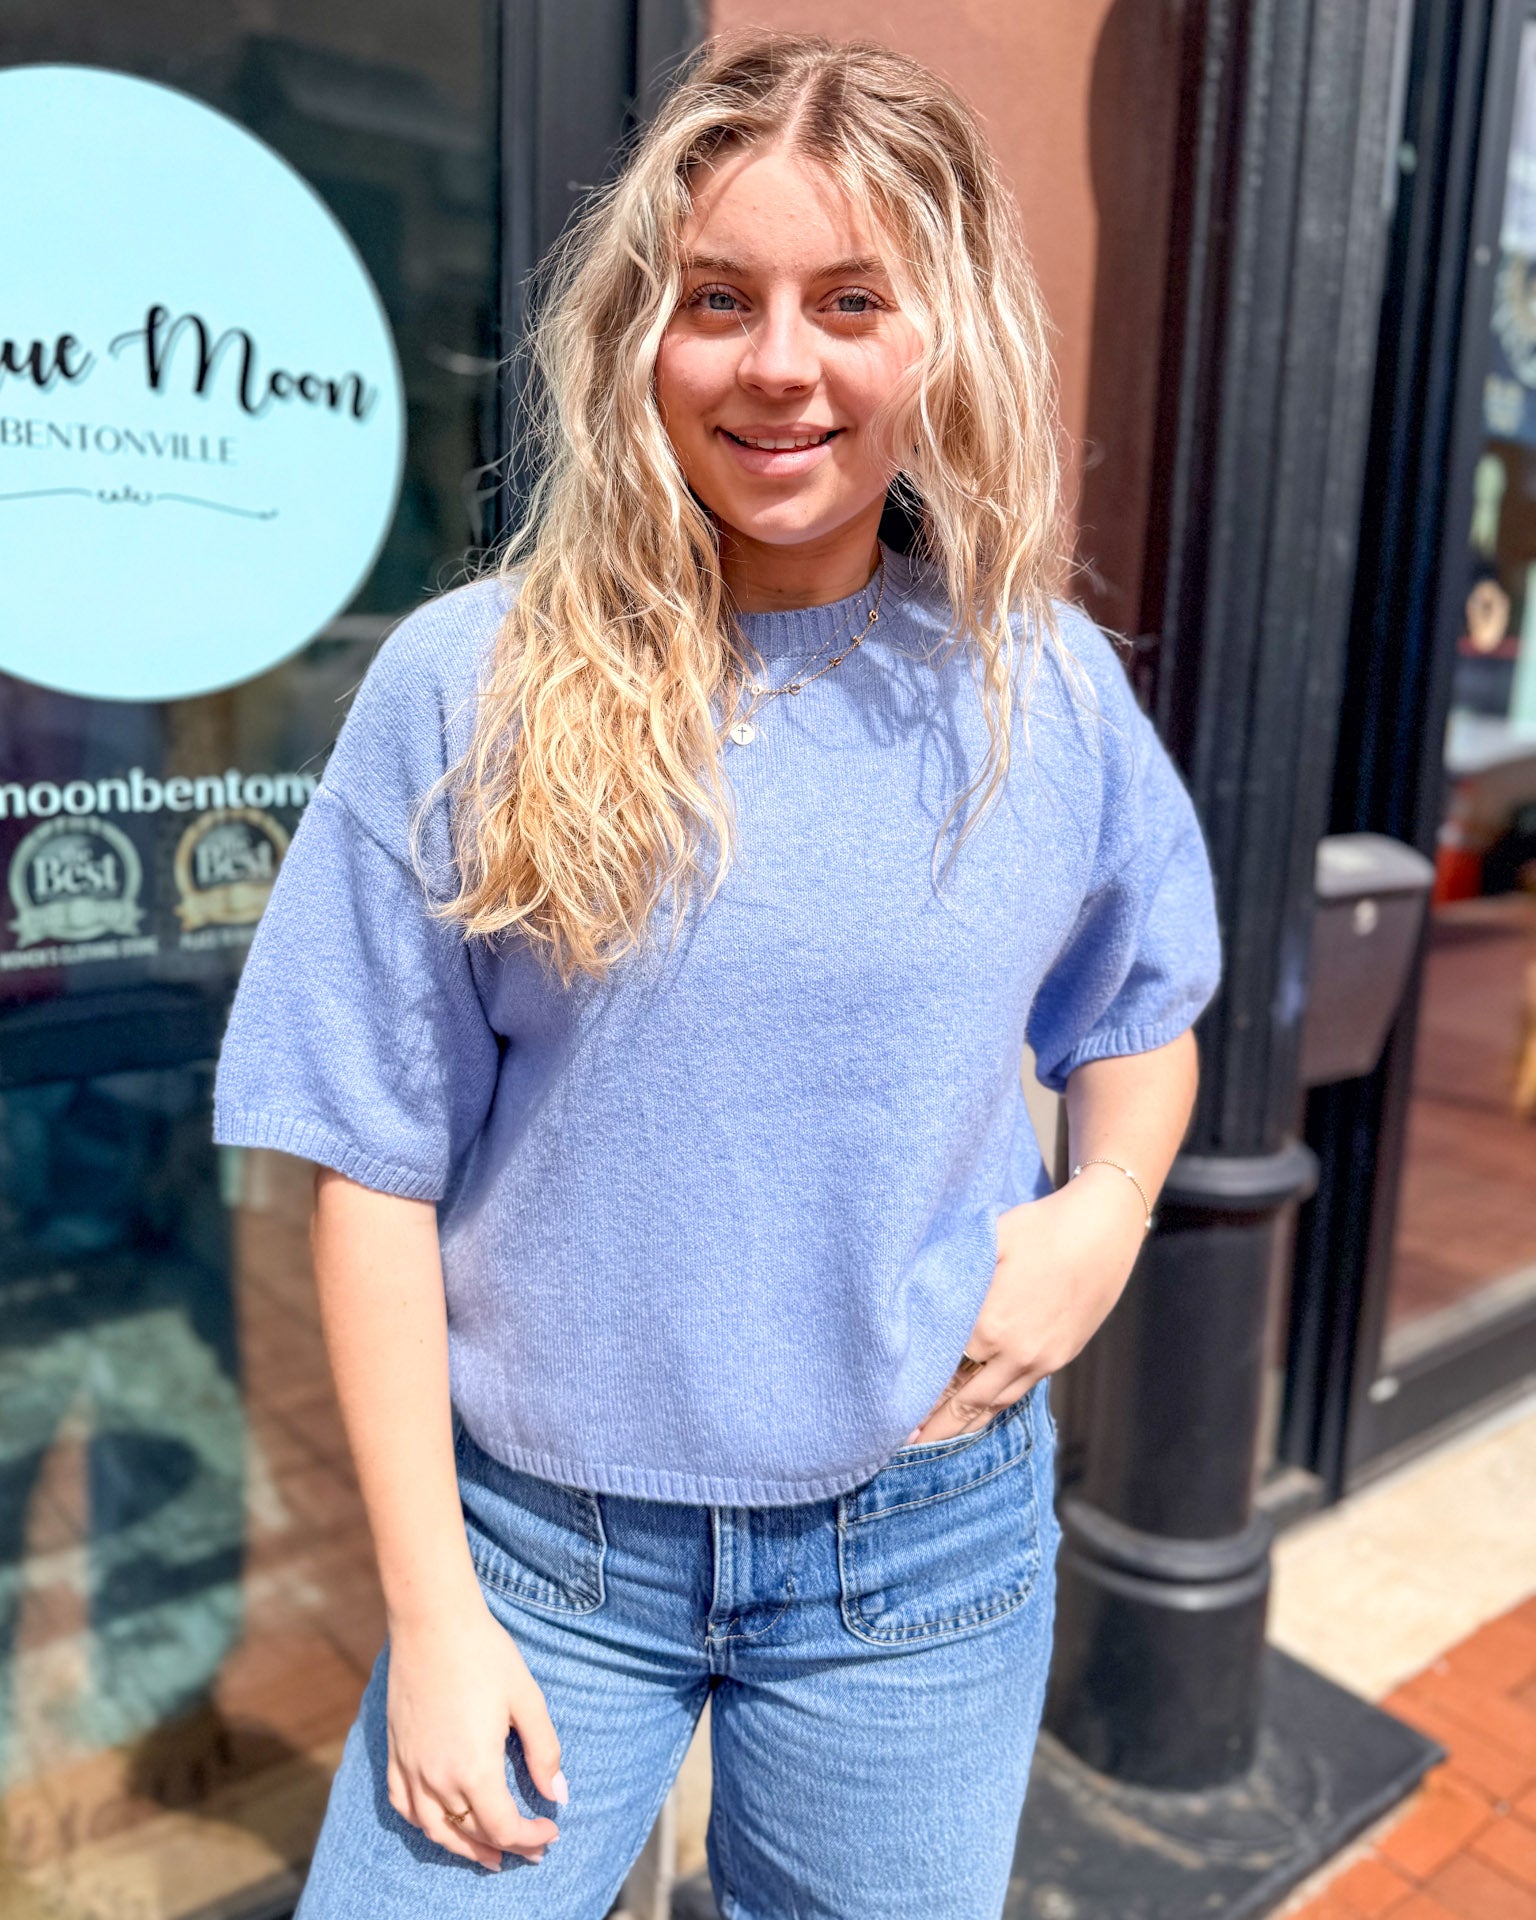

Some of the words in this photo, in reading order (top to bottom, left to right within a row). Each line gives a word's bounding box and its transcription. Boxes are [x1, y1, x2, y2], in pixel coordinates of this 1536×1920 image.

[108, 303, 374, 419] Moon
[0, 416, 238, 464] BENTONVILLE
[33, 852, 117, 895] Best
[197, 840, 273, 884] Best
